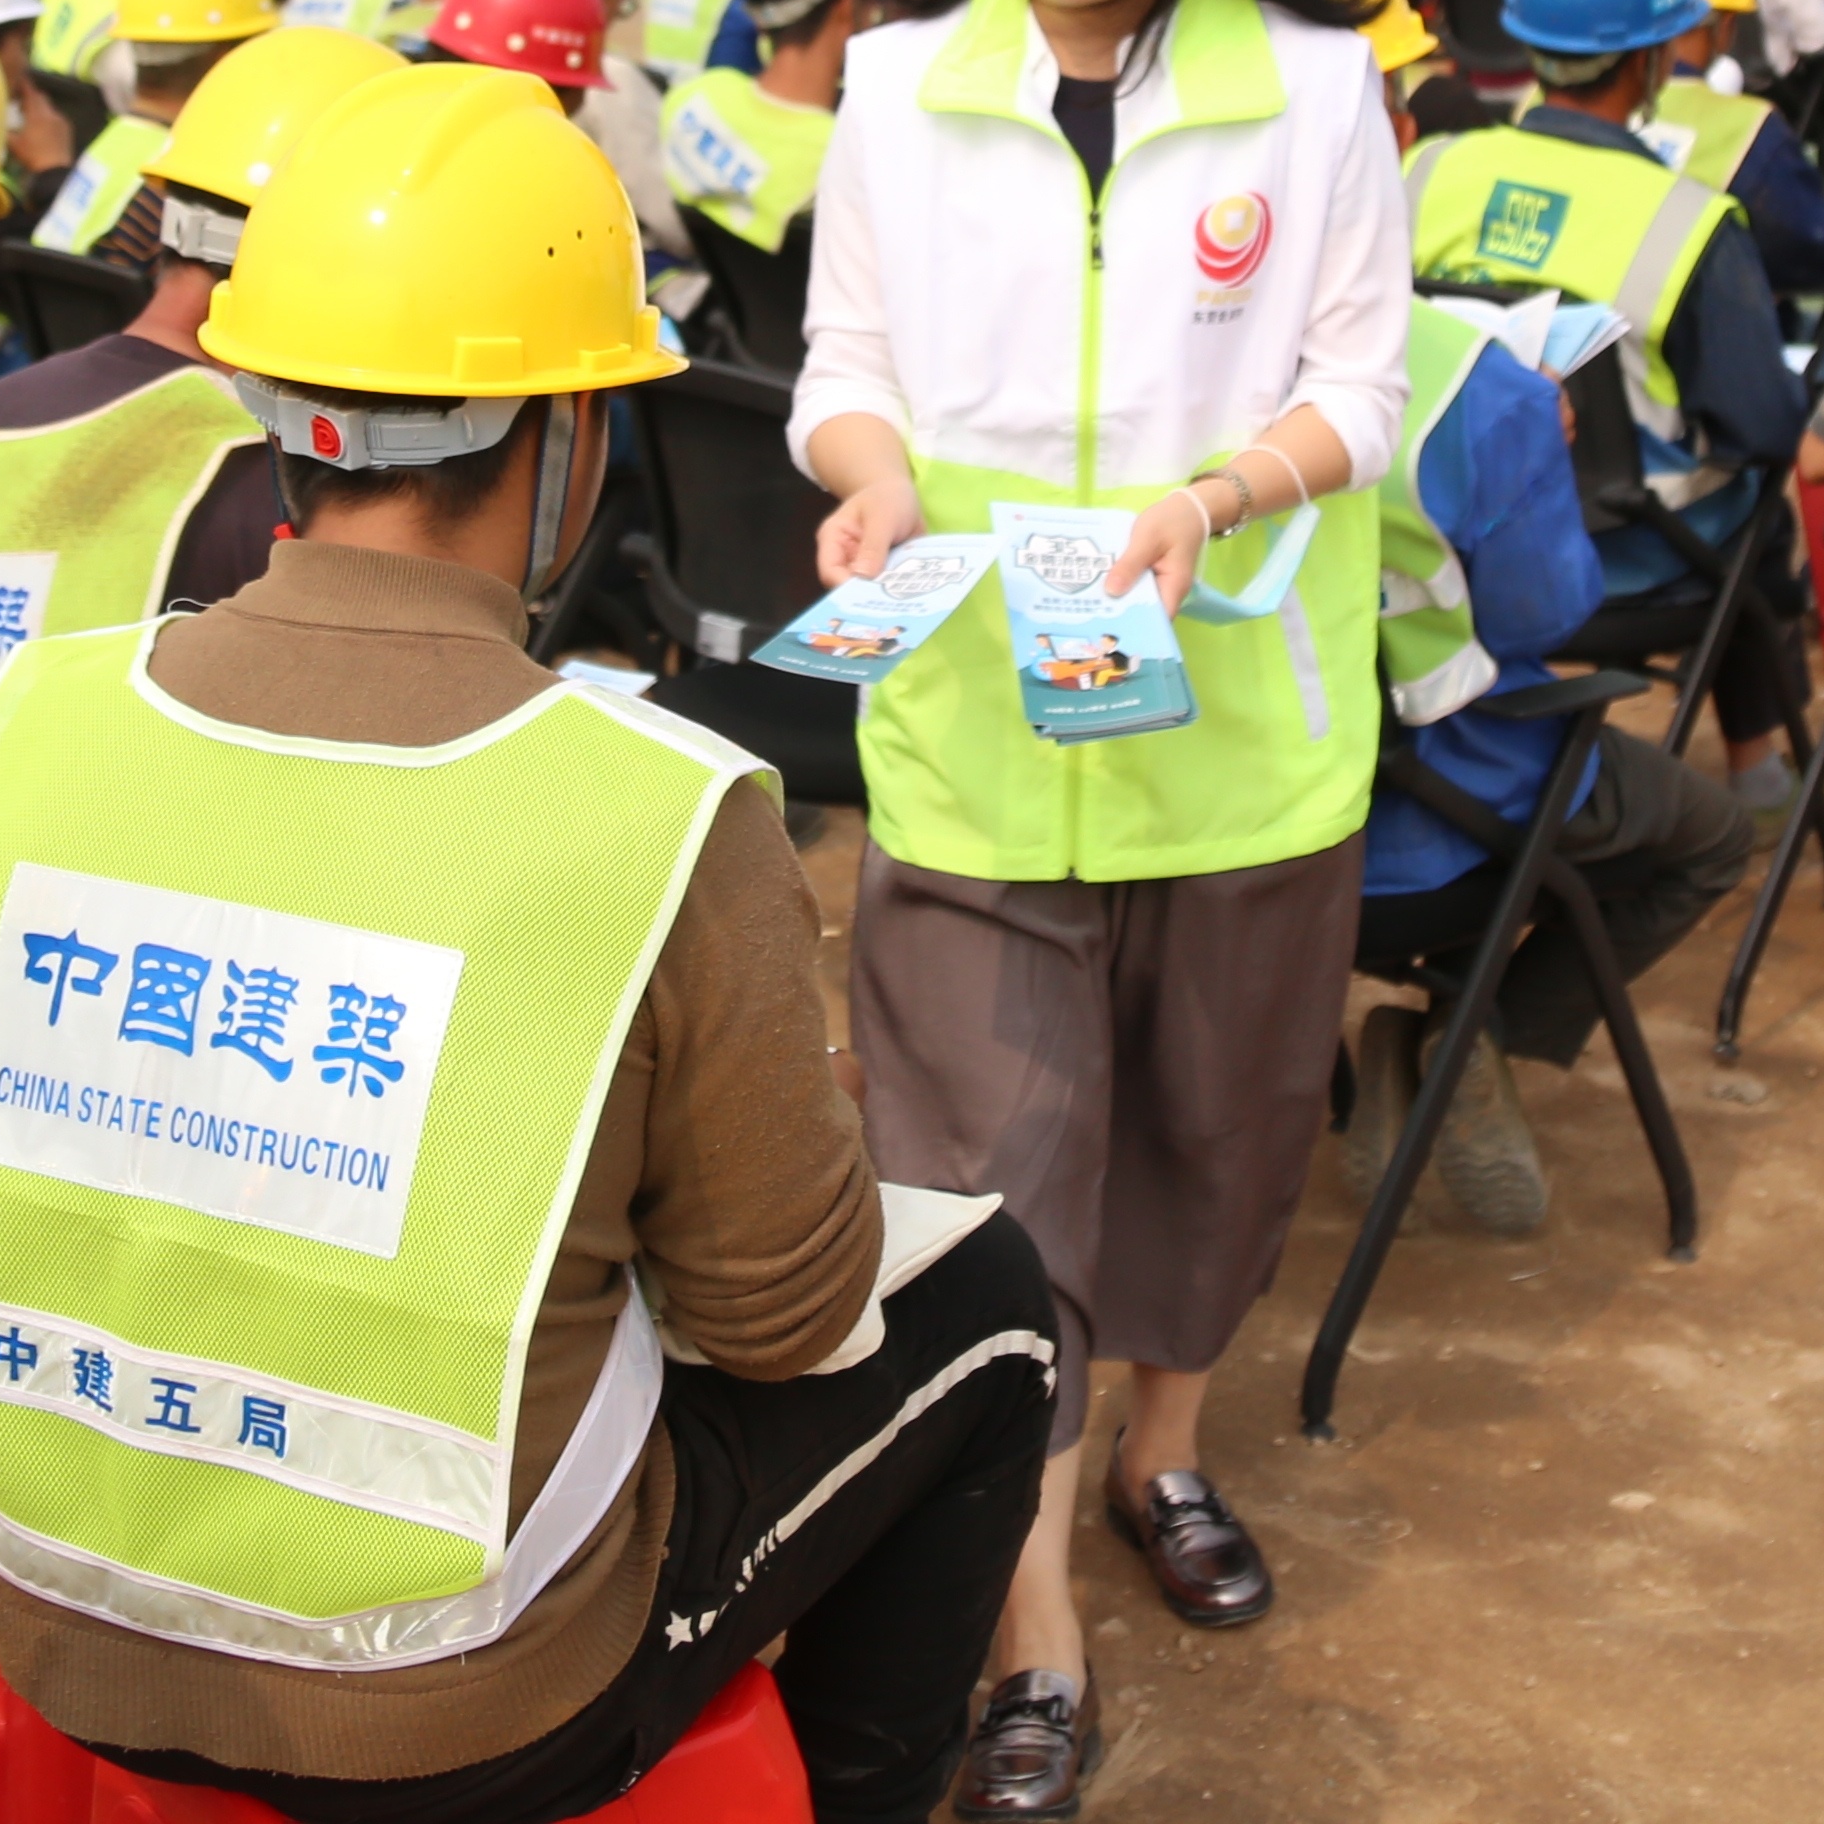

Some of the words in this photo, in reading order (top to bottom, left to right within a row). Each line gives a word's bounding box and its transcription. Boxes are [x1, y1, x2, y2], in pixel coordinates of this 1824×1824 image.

[22, 928, 407, 1099] 中國建築
[77, 1088, 161, 1140] STATE
[170, 1105, 391, 1193] CONSTRUCTION
